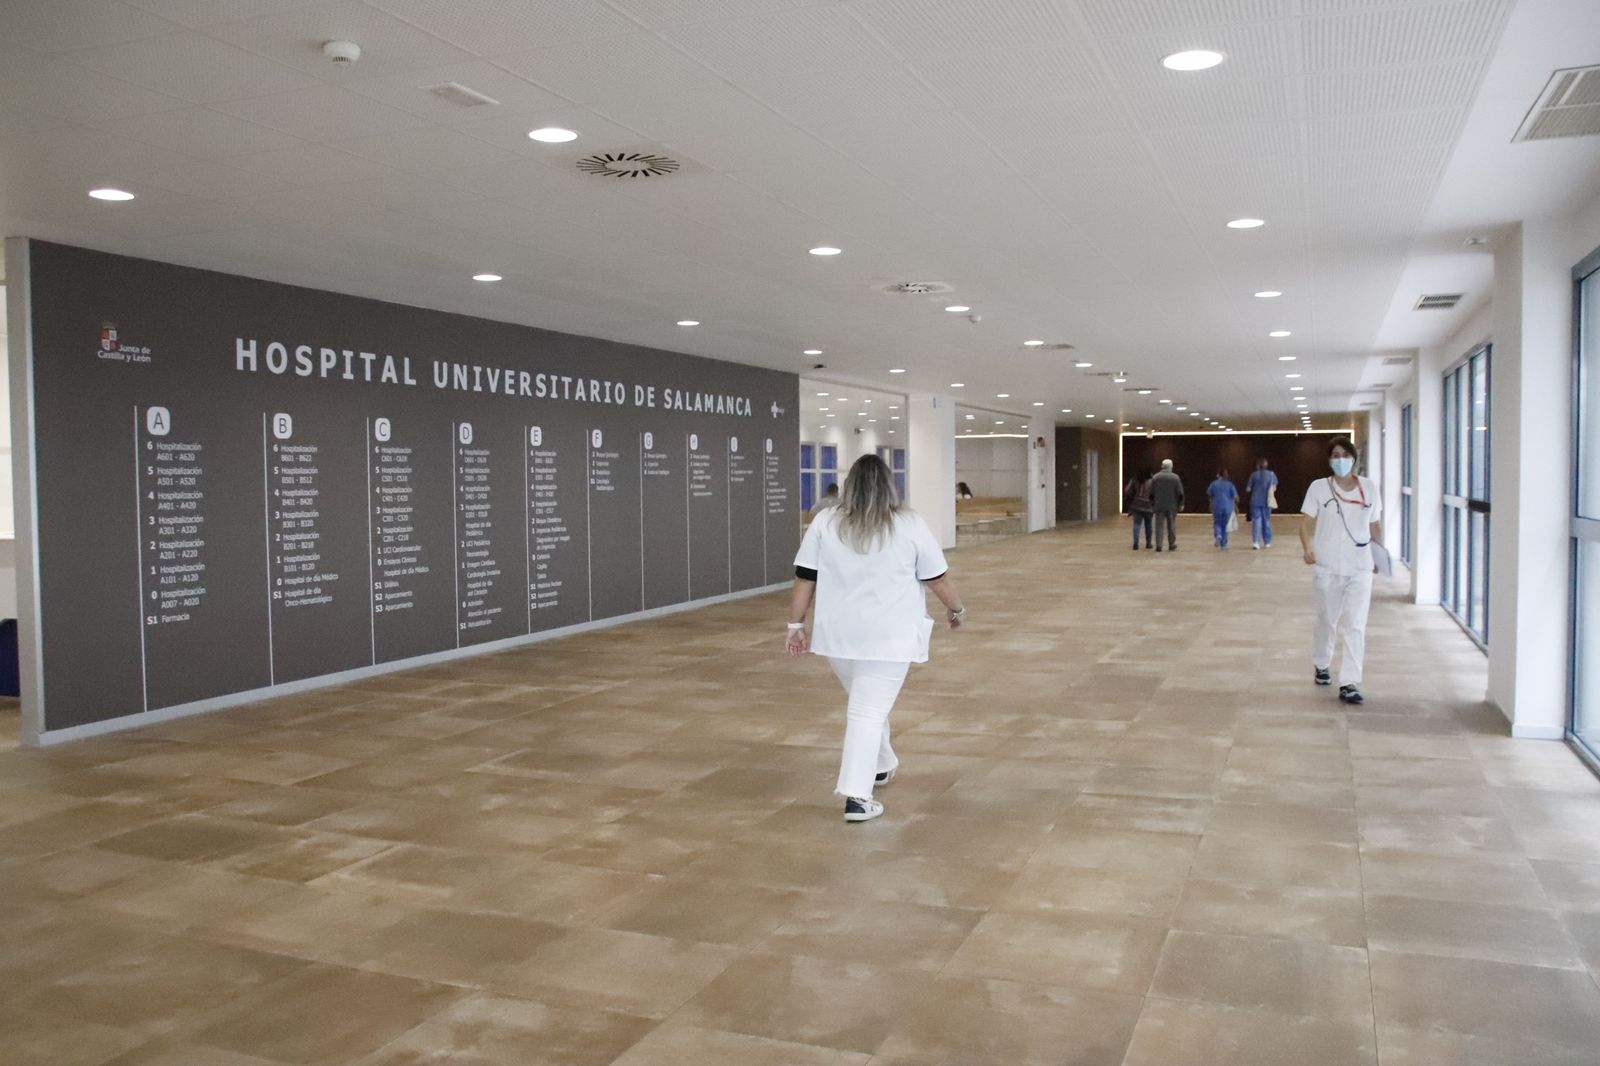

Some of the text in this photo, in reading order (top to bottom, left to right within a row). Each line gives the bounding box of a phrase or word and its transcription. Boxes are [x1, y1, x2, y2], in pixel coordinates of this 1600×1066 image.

[119, 344, 151, 354] Junta de
[98, 350, 151, 363] Castilla y León
[236, 338, 752, 417] HOSPITAL UNIVERSITARIO DE SALAMANCA
[153, 411, 164, 429] A
[279, 418, 287, 433] B
[379, 422, 387, 437] C
[463, 427, 469, 440] D
[147, 441, 202, 451] 6 Hospitalización
[273, 444, 278, 452] 6
[375, 446, 380, 454] 6
[147, 466, 202, 475] 5 Hospitalización
[274, 467, 279, 475] 5
[148, 491, 203, 500] 4 Hospitalización
[274, 489, 279, 497] 4
[275, 511, 280, 519] 3
[149, 515, 204, 525] 3 Hospitalización
[275, 533, 281, 541] 2
[150, 538, 205, 550] 2 Hospitalización
[276, 556, 281, 564] 1
[377, 558, 382, 566] 0
[151, 562, 206, 575] 1 Hospitalización
[276, 578, 282, 586] 0
[374, 582, 382, 590] S1
[151, 587, 206, 599] 0 Hospitalización
[273, 591, 282, 599] S1
[375, 593, 383, 601] S2
[375, 604, 383, 612] S3
[147, 614, 190, 625] S1 Farmacia
